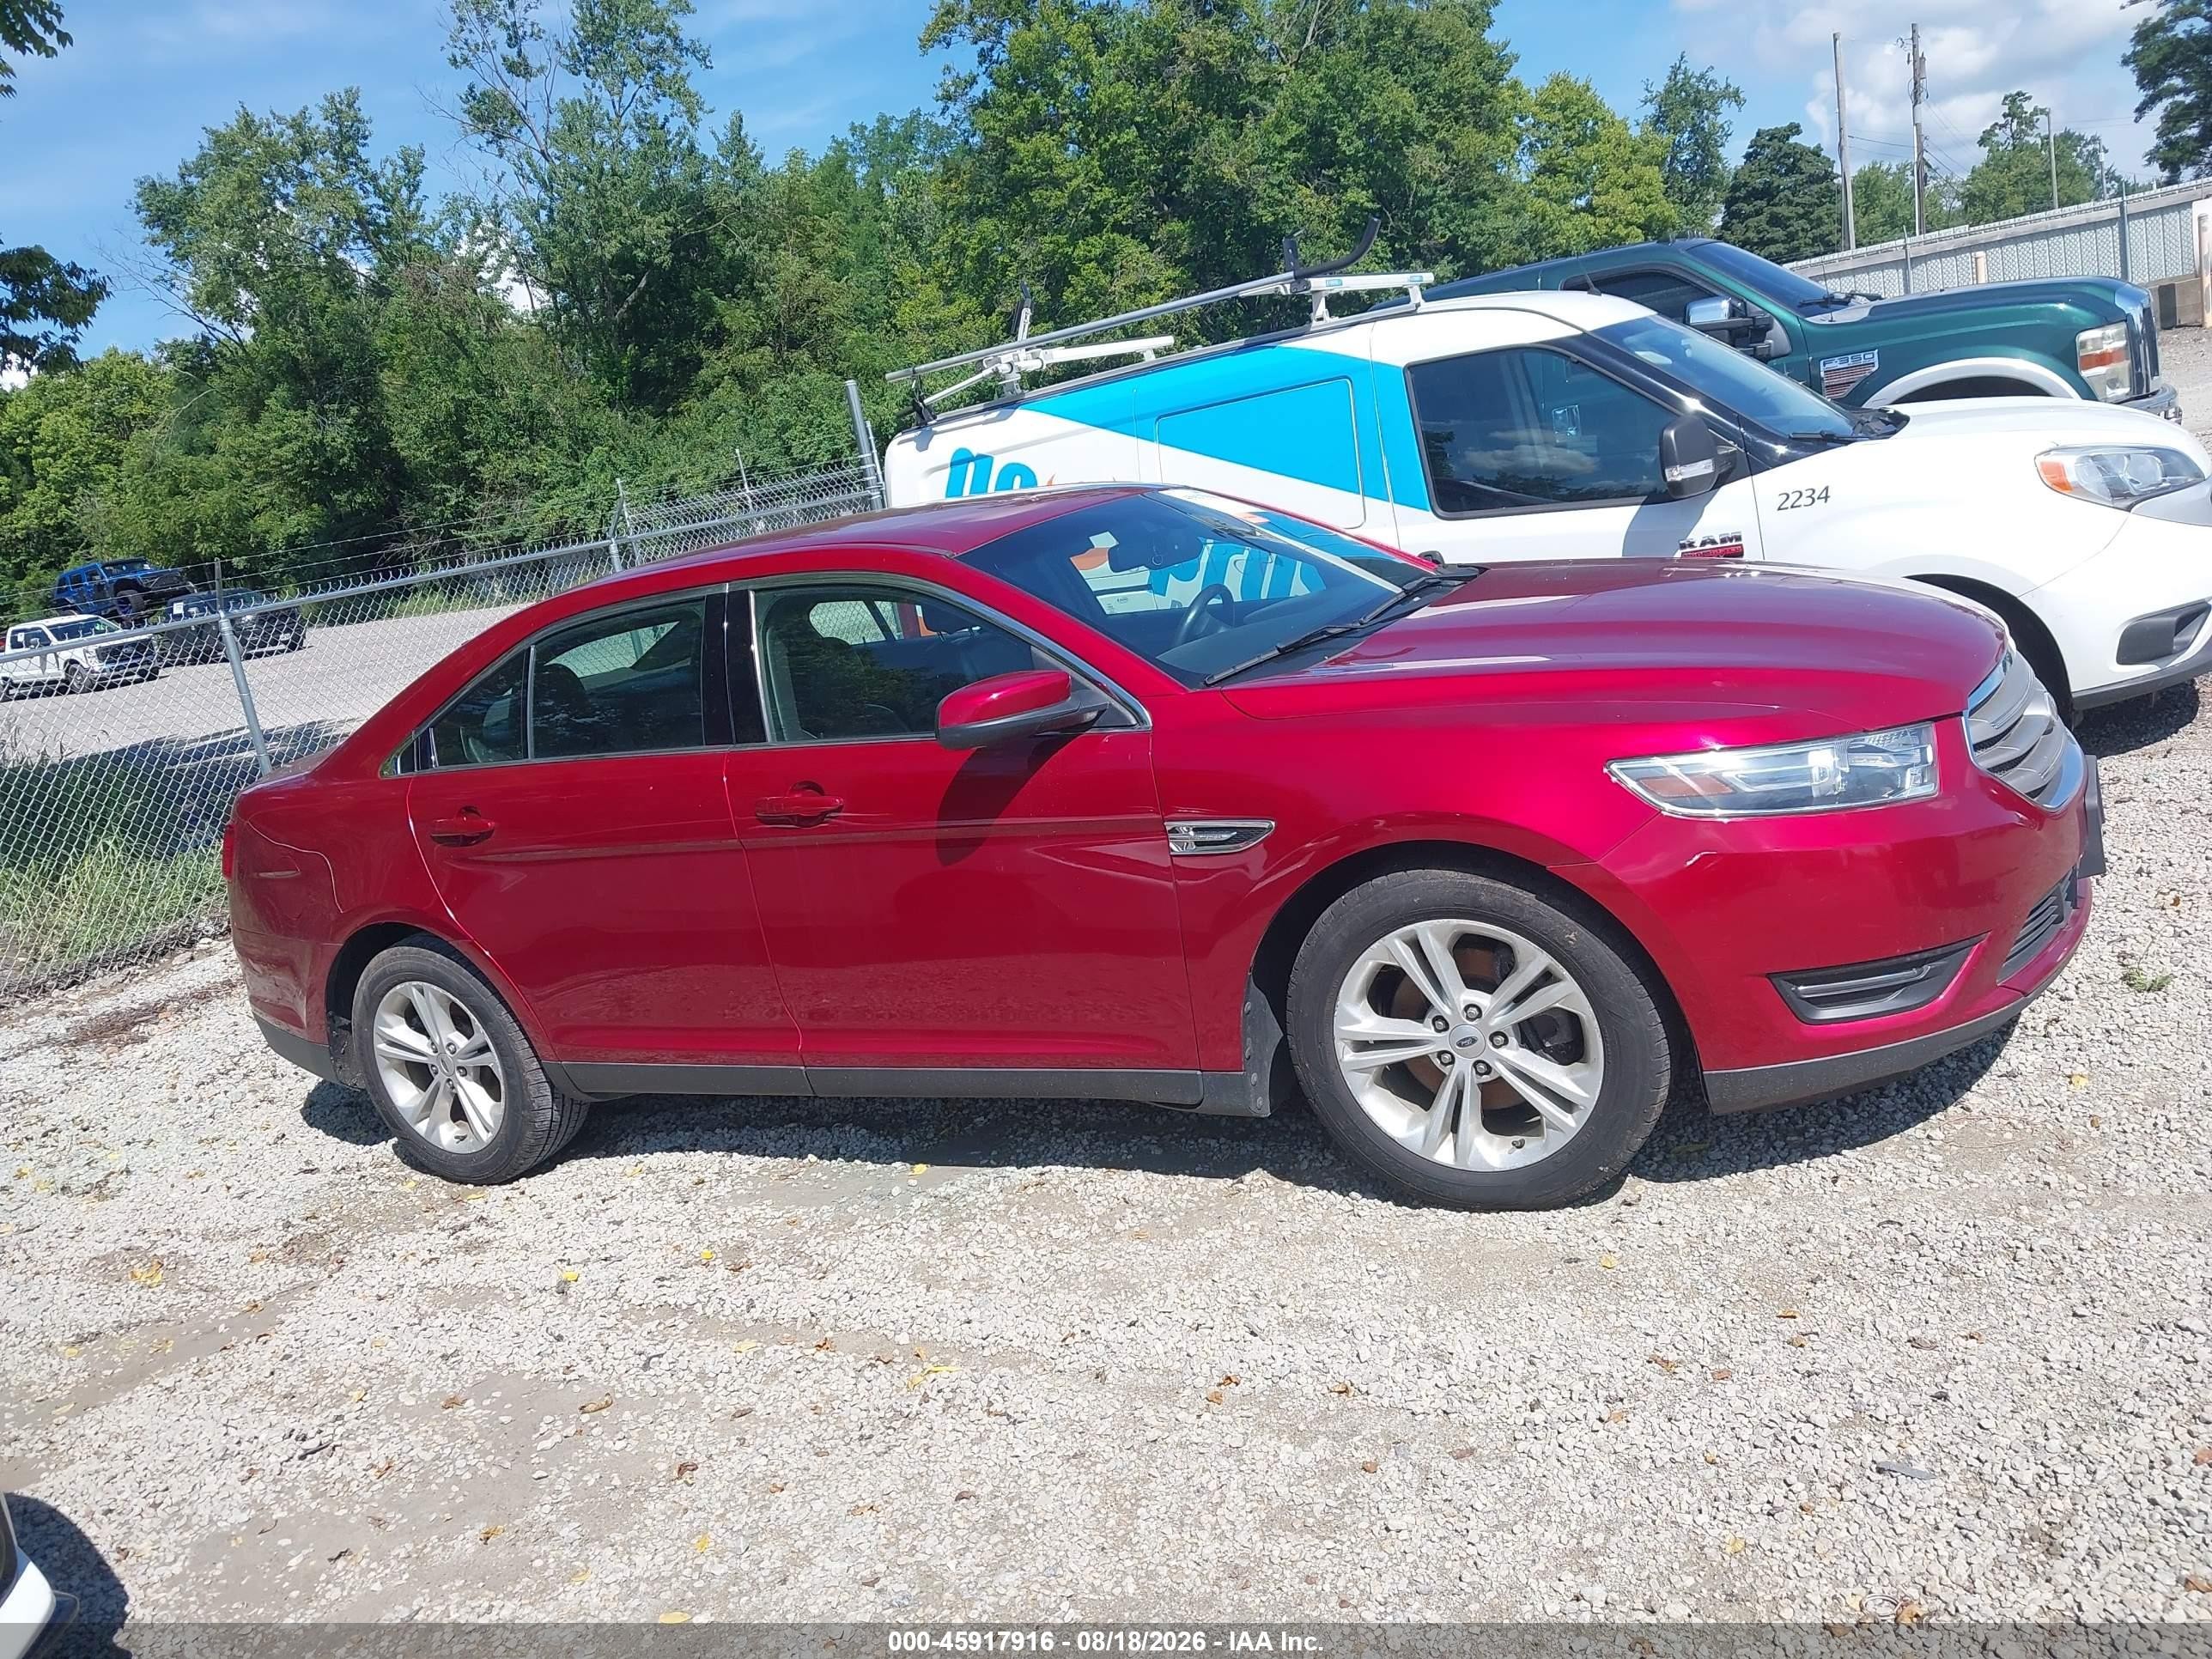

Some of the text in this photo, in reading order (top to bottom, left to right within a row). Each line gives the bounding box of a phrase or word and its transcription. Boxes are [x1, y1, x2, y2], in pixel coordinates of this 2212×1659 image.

[1823, 352, 1875, 367] F-350
[1777, 485, 1831, 511] 2234
[1679, 532, 1742, 550] RAM
